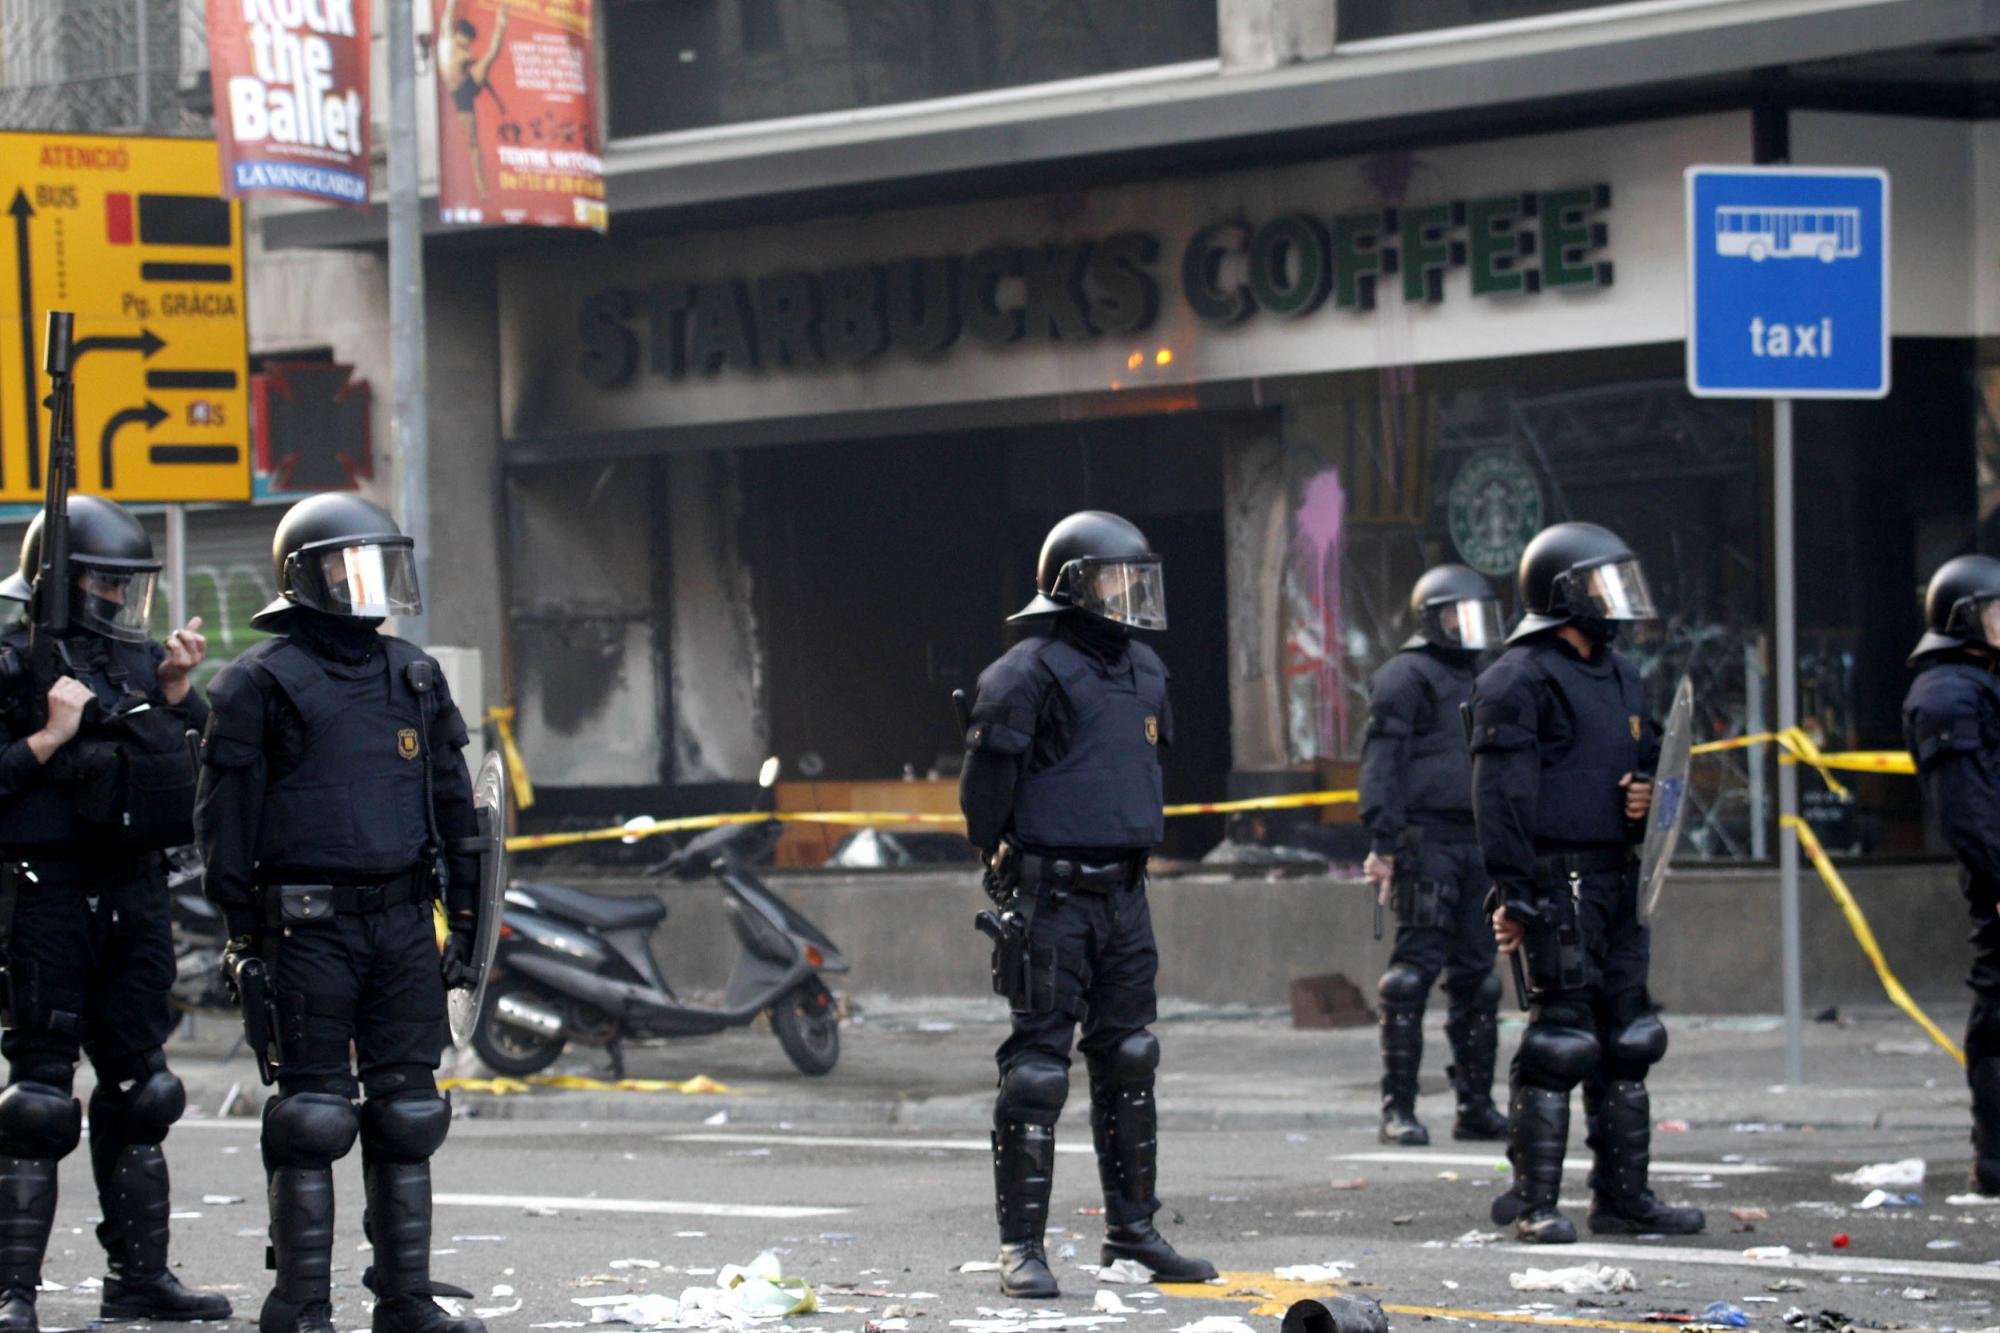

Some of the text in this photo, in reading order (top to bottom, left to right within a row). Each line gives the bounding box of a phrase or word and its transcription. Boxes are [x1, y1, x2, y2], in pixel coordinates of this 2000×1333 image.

[249, 22, 334, 92] the
[228, 75, 363, 157] Ballet
[39, 143, 129, 171] ATENCIÓ
[36, 184, 78, 208] BUS
[161, 288, 237, 318] GRÀCIA
[578, 183, 1614, 388] STARBUCKS COFFEE
[1749, 316, 1833, 358] taxi
